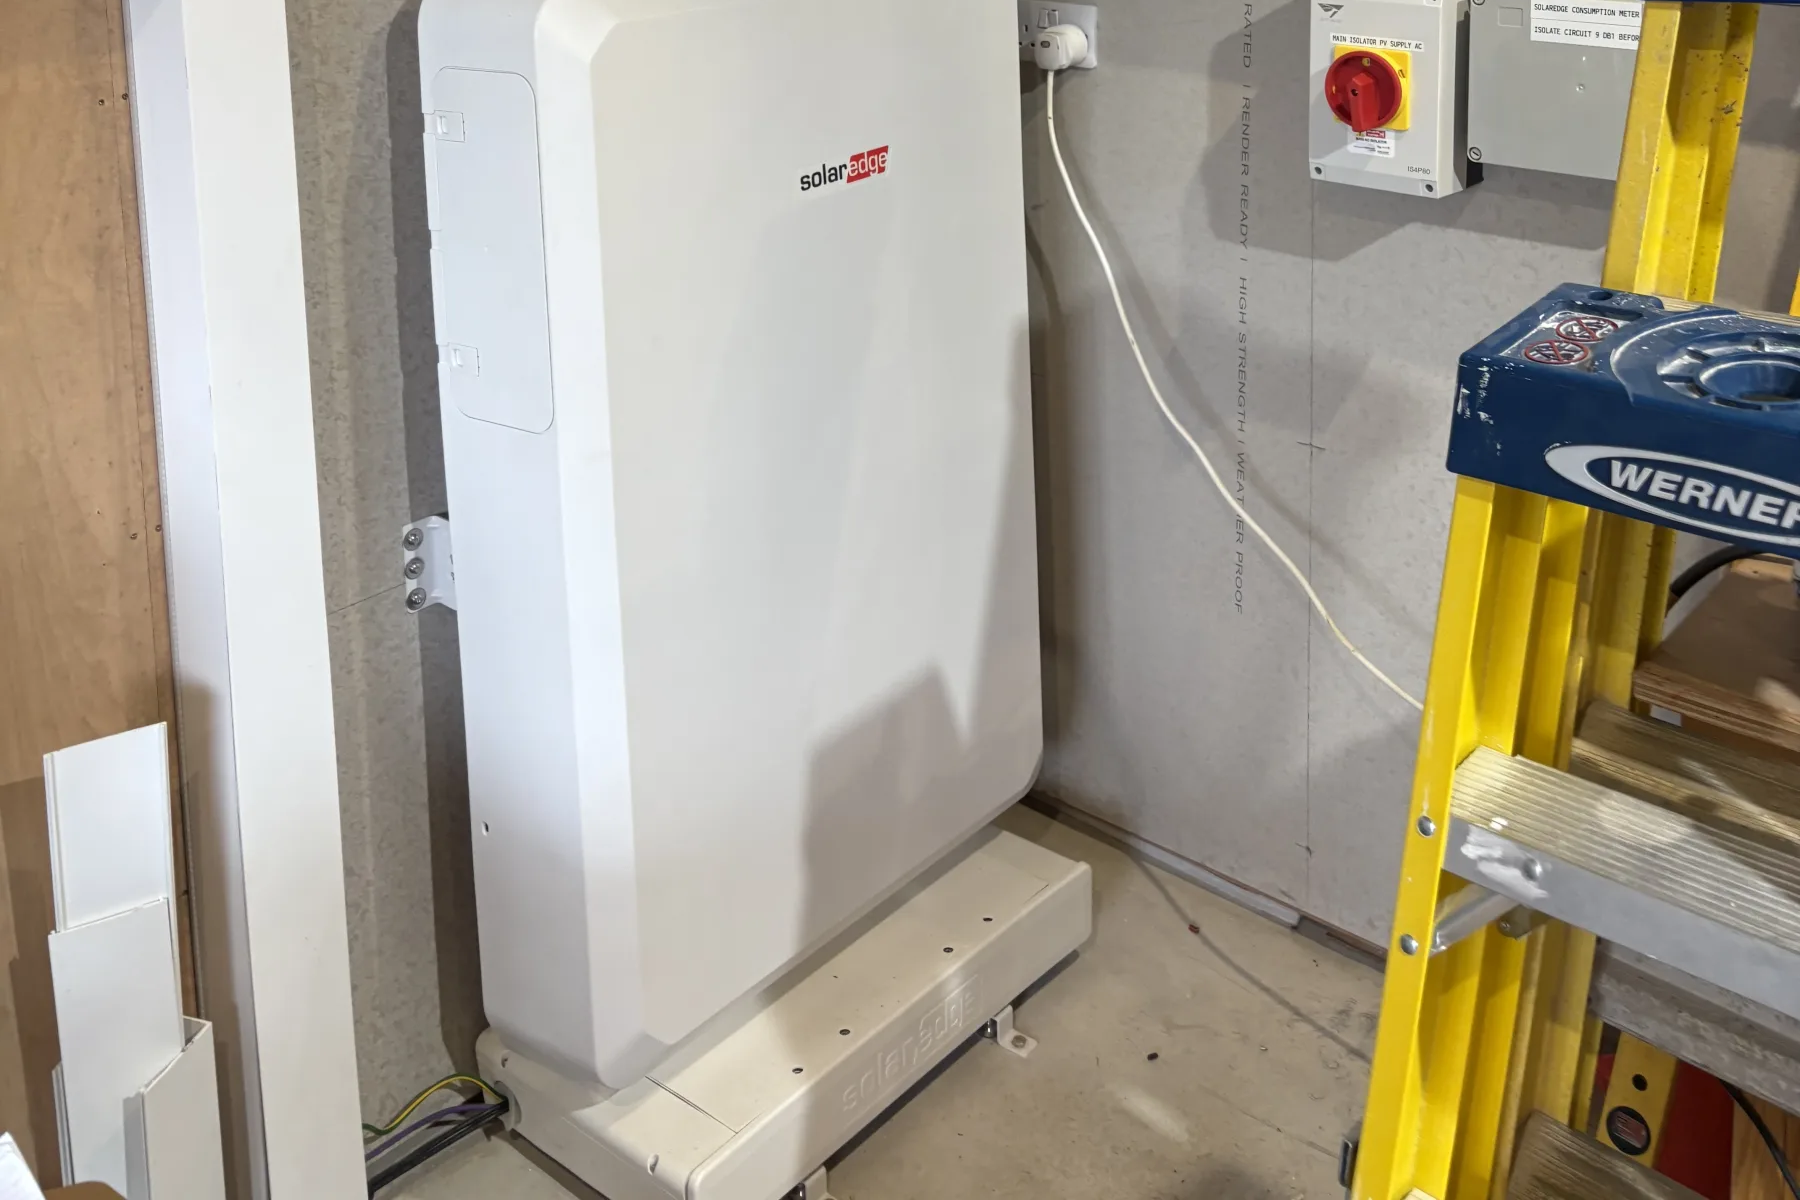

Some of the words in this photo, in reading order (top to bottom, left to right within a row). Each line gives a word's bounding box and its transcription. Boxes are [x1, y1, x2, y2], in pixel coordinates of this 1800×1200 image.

[1534, 4, 1568, 12] SOLAREDGE
[1572, 6, 1616, 16] CONSUMPTION
[1618, 10, 1640, 18] METER
[1534, 26, 1560, 34] ISOLATE
[1564, 29, 1592, 37] CIRCUIT
[1243, 3, 1252, 68] RATED
[1332, 35, 1347, 43] MAIN
[1350, 36, 1377, 45] ISOLATOR
[1241, 97, 1251, 176] RENDER
[800, 147, 888, 191] solaredge
[1408, 166, 1430, 174] IS4P80
[1240, 184, 1249, 248] READY
[1238, 276, 1247, 324] HIGH
[1237, 332, 1247, 432] STRENGTH
[1234, 552, 1244, 614] PROOF
